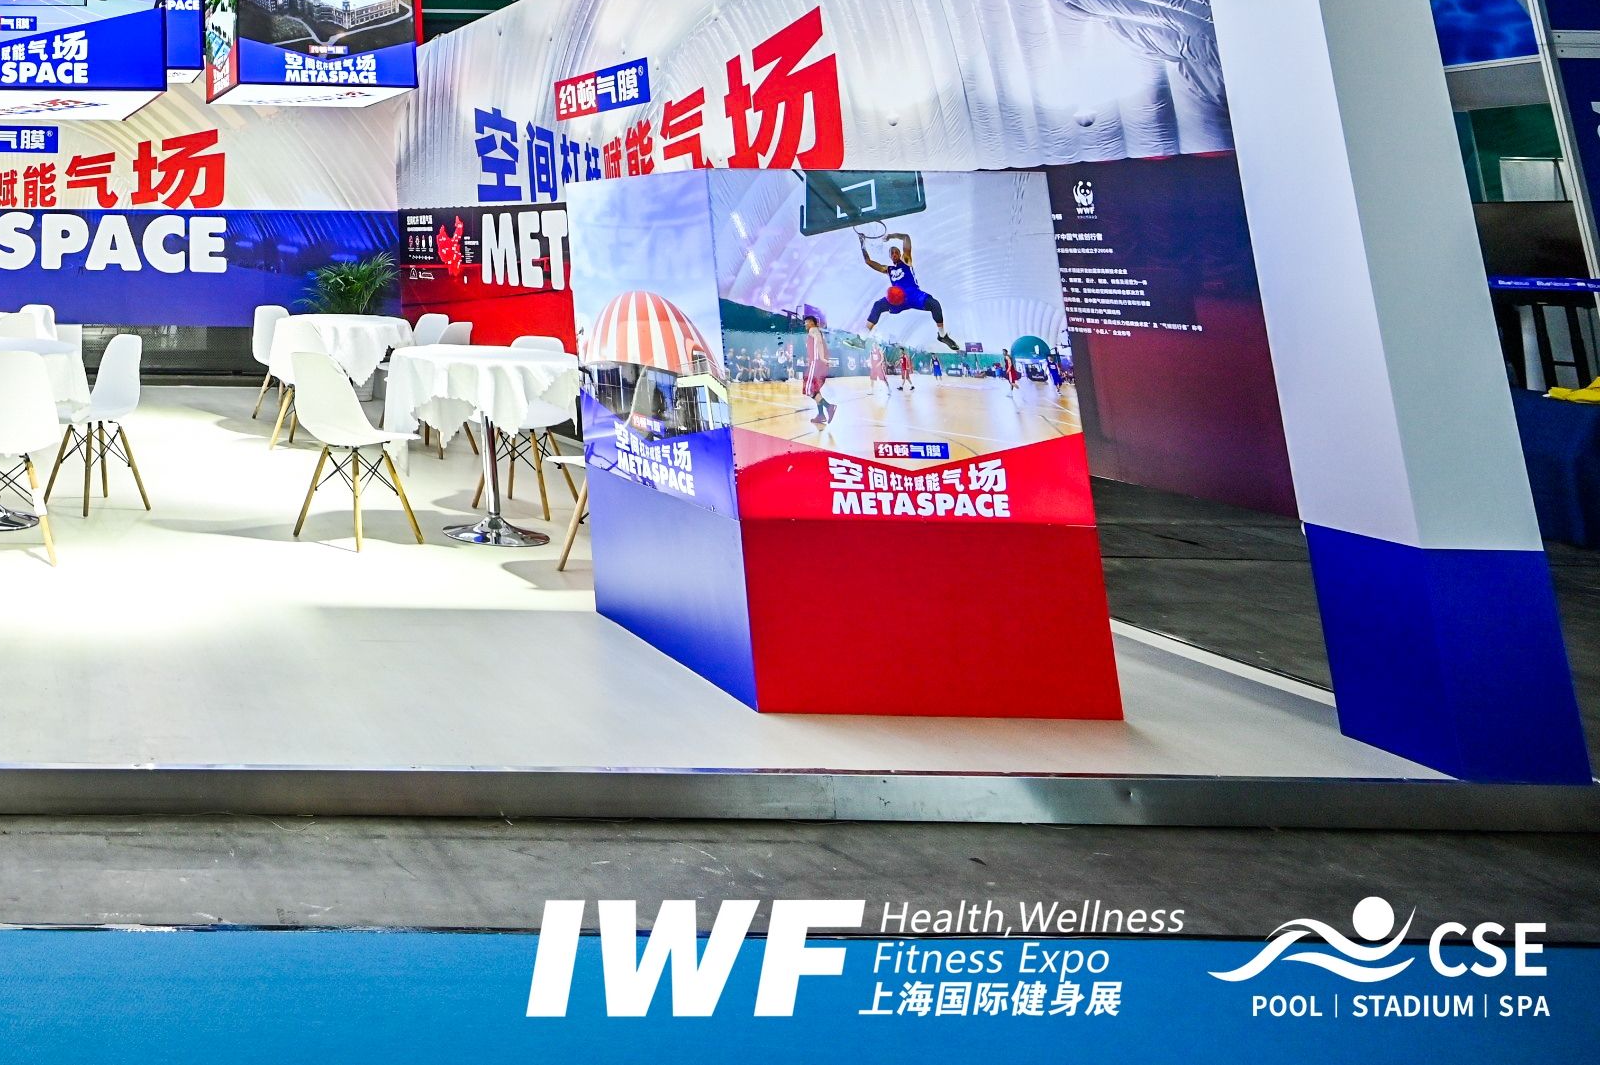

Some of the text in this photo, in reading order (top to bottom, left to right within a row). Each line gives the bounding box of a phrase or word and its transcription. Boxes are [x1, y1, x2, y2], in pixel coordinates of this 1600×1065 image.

[284, 70, 378, 85] METASPACE
[1076, 206, 1095, 215] WWF
[617, 449, 696, 497] METASPACE
[828, 456, 1007, 492] 空间杠杆赋能气场
[832, 491, 1011, 518] METASPACE
